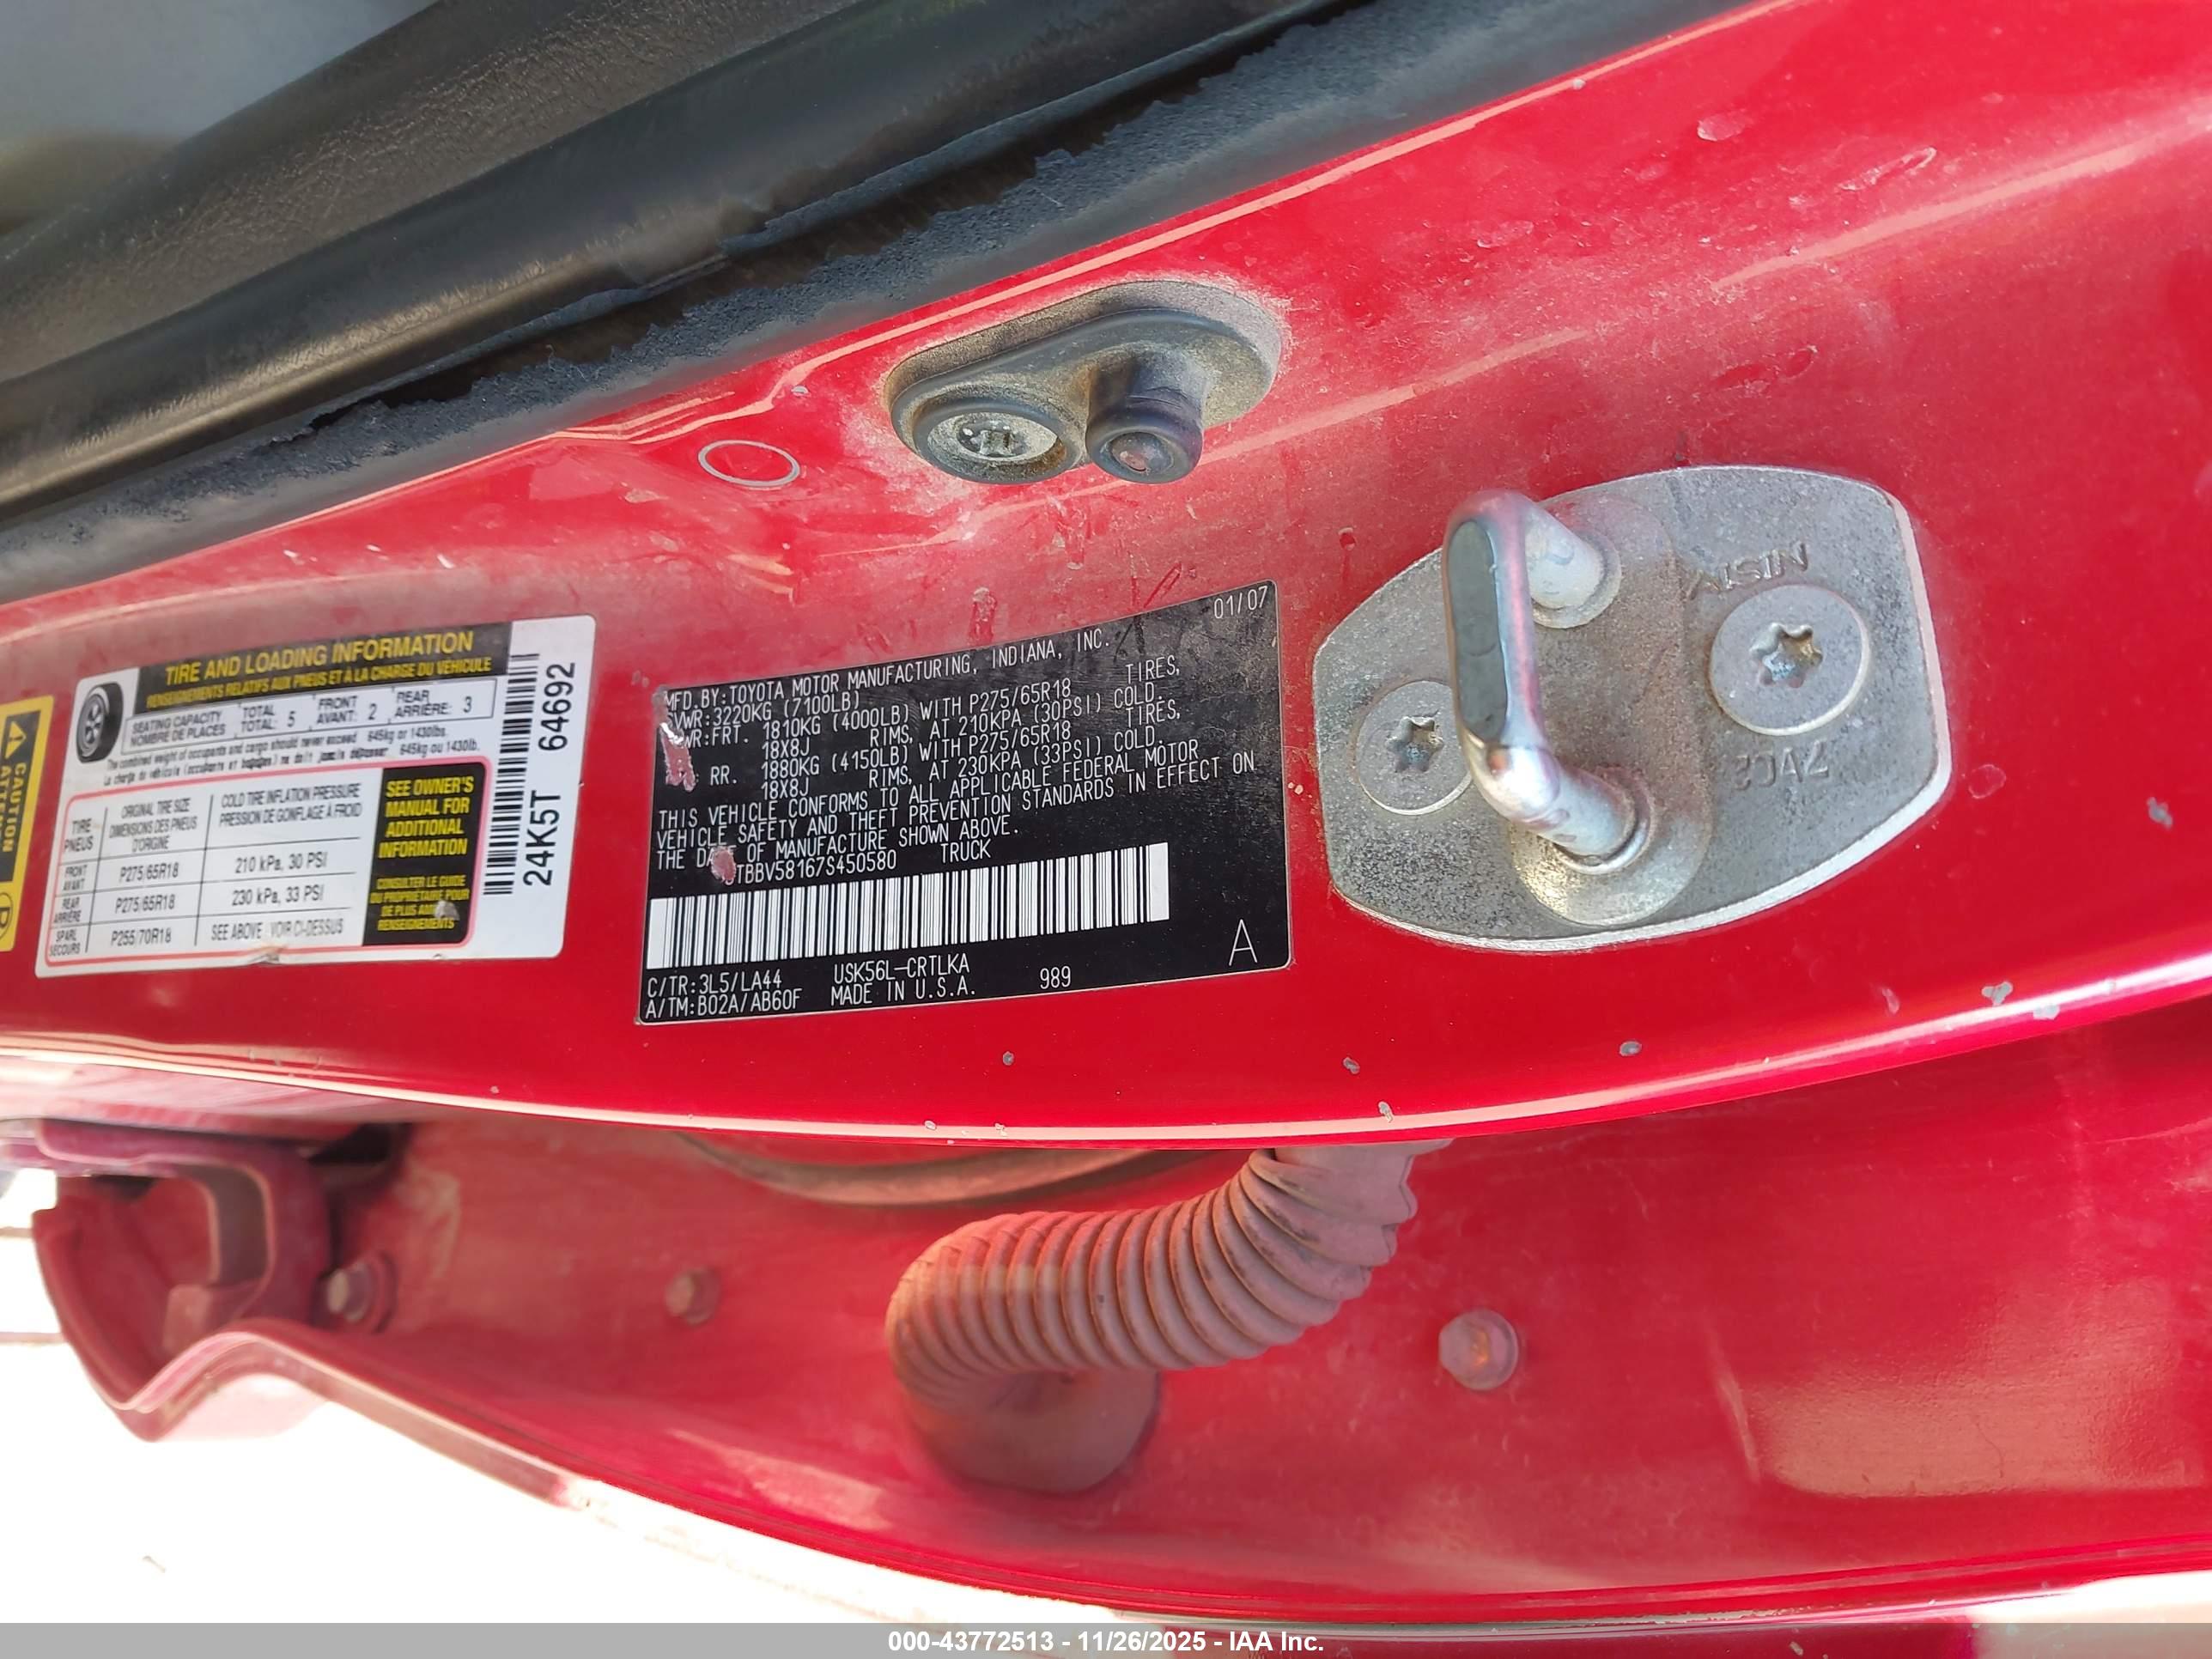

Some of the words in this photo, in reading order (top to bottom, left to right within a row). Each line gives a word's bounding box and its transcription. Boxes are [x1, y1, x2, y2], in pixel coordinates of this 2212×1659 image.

[1214, 586, 1267, 618] 01/07
[166, 662, 201, 686] TIRE
[204, 656, 240, 680] AND
[246, 645, 327, 674] LOADING
[331, 630, 474, 663] INFORMATION
[792, 673, 839, 696] MOTOR
[848, 654, 977, 690] MANUFACTURING,
[993, 639, 1062, 668] INDIANA,
[1077, 629, 1109, 652] INC.
[329, 669, 343, 684] ET
[356, 667, 369, 682] LA
[416, 661, 435, 678] DU
[318, 696, 358, 710] FRONT
[397, 690, 429, 704] REAR
[464, 696, 472, 714] 3
[538, 662, 575, 750] 64692
[763, 715, 821, 739] 1810KG
[833, 703, 908, 732] (4000LB)
[920, 696, 962, 720] WITH
[969, 678, 1072, 714] P275/65R18
[1126, 654, 1180, 684] TIRES,
[784, 690, 859, 717] (7100LB)
[131, 717, 172, 735] SEATING
[173, 710, 222, 727] CAPACITY
[241, 719, 277, 732] TOTAL:
[287, 711, 296, 728] 5
[243, 704, 275, 718] TOTAL
[317, 710, 357, 724] AVANT:
[368, 703, 378, 720] 2
[762, 737, 810, 760] 18X8J
[870, 724, 914, 747] RIMS,
[930, 719, 949, 739] AT
[958, 708, 1022, 737] 210KPA
[1034, 692, 1100, 724] (30PSI)
[1114, 682, 1163, 708] COLD.
[131, 732, 170, 748] NOMBRE
[173, 728, 185, 741] DE
[187, 724, 226, 740] PLACES
[368, 730, 395, 744] 645kg
[397, 730, 408, 739] or
[710, 765, 737, 786] RR.
[761, 756, 819, 780] 1880KG
[831, 744, 908, 773] (4150LB)
[919, 738, 961, 762] WITH
[969, 720, 1072, 755] P275/65R18
[1126, 699, 1181, 727] TIRES,
[400, 743, 428, 757] 645kg
[431, 743, 442, 752] ou
[761, 778, 809, 800] 18X8J
[869, 766, 912, 789] RIMS,
[929, 760, 949, 781] AT
[958, 750, 1022, 778] 230KPA
[1034, 736, 1100, 766] (33PSI)
[1114, 726, 1163, 751] COLD.
[221, 792, 245, 809] COLD
[247, 789, 265, 806] TIRE
[266, 787, 312, 804] INFLATION
[313, 782, 362, 800] PRESSURE
[386, 780, 411, 798] SEE
[414, 776, 474, 795] OWNER'S
[659, 808, 697, 830] THIS
[708, 800, 778, 825] VEHICLE
[789, 791, 868, 818] CONFORMS
[881, 787, 899, 807] TO
[909, 784, 939, 804] ALL
[949, 765, 1052, 799] APPLICABLE
[1063, 752, 1134, 783] FEDERAL
[1145, 739, 1199, 769] MOTOR
[3, 761, 27, 854] CAUTION
[122, 802, 154, 818] ORIGINAL
[157, 799, 173, 815] TIRE
[173, 798, 191, 812] SIZE
[385, 799, 440, 817] MANUAL
[443, 797, 471, 815] FOR
[657, 826, 727, 849] VEHICLE
[738, 819, 798, 843] SAFETY
[807, 815, 837, 836] AND
[849, 808, 897, 831] THEFT
[909, 793, 1011, 825] PREVENTION
[1022, 778, 1114, 810] STANDARDS
[1129, 771, 1146, 793] IN
[1157, 757, 1219, 788] EFFECT
[1233, 750, 1255, 774] ON
[72, 817, 92, 835] TIRE
[219, 811, 261, 827] PRESSION
[262, 809, 276, 823] DE
[276, 805, 325, 823] GONFLAGE
[335, 802, 363, 818] FROID
[109, 821, 154, 838] DIMENSIONS
[155, 819, 169, 832] DES
[171, 816, 198, 831] PNEUS
[385, 818, 465, 838] ADDITIONAL
[523, 790, 561, 886] 24K5T
[64, 836, 94, 853] PNEUS
[378, 838, 468, 859] INFORMATION
[658, 849, 685, 870] THE
[747, 842, 766, 863] OF
[776, 830, 888, 860] MANUFACTURE
[899, 823, 948, 847] SHOWN
[959, 815, 1018, 840] ABOVE.
[65, 865, 88, 878] FRONT
[119, 862, 179, 883] P275/65R18
[234, 856, 256, 874] 210
[258, 854, 284, 872] kPa,
[288, 853, 303, 870] 30
[306, 851, 328, 869] PSI
[725, 850, 896, 885] TBBV58167S450580
[941, 839, 991, 863] TRUCK
[63, 878, 84, 891] AVANT
[232, 889, 253, 907] 230
[257, 887, 282, 905] kPa,
[285, 886, 301, 902] 33
[303, 884, 325, 901] PSI
[62, 896, 80, 910] REAR
[115, 894, 176, 914] P275/65R18
[111, 927, 172, 947] P255/70R18
[211, 924, 230, 942] SEE
[231, 921, 263, 940] ABOVE
[269, 921, 292, 938] VOIR
[294, 918, 343, 937] CI-DESSUS
[49, 942, 80, 957] SECOURS
[1229, 919, 1258, 966] A
[834, 952, 970, 985] USK56L-CRTLKA
[1039, 966, 1071, 989] 989
[647, 969, 781, 997] C/TR:3L5/LA44
[831, 982, 872, 1006] MADE
[887, 980, 904, 1001] IN
[915, 975, 975, 1000] U.S.A.
[646, 988, 802, 1018] A/TM:B02A/AB60F
